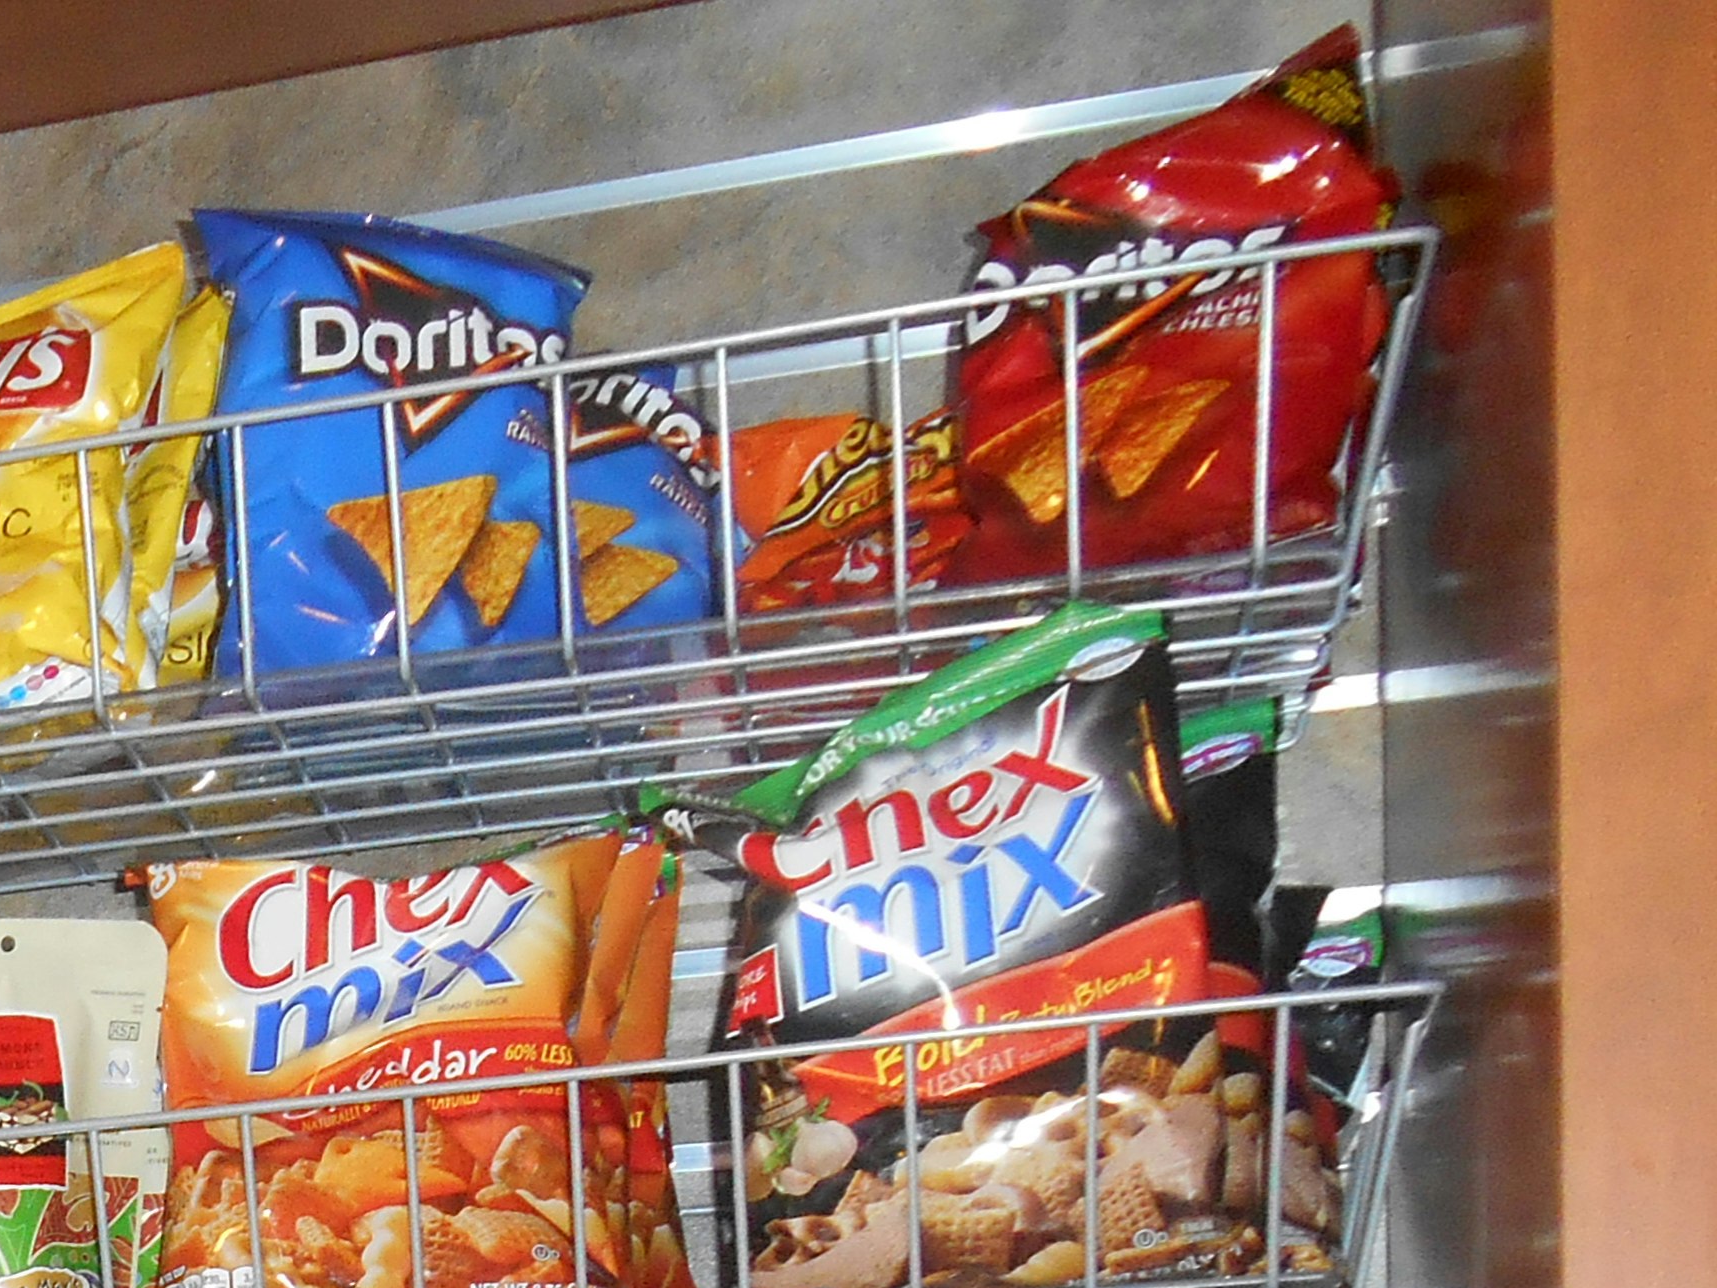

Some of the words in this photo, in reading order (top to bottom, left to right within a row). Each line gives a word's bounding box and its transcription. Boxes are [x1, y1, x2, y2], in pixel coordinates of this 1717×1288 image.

[298, 304, 566, 377] Doritos
[967, 226, 1287, 346] Doritos
[218, 861, 537, 991] Chex
[797, 785, 1106, 1013] mix
[248, 896, 540, 1076] mix
[504, 1043, 537, 1061] 60%
[540, 1043, 574, 1065] LESS
[976, 1047, 1015, 1078] FAT
